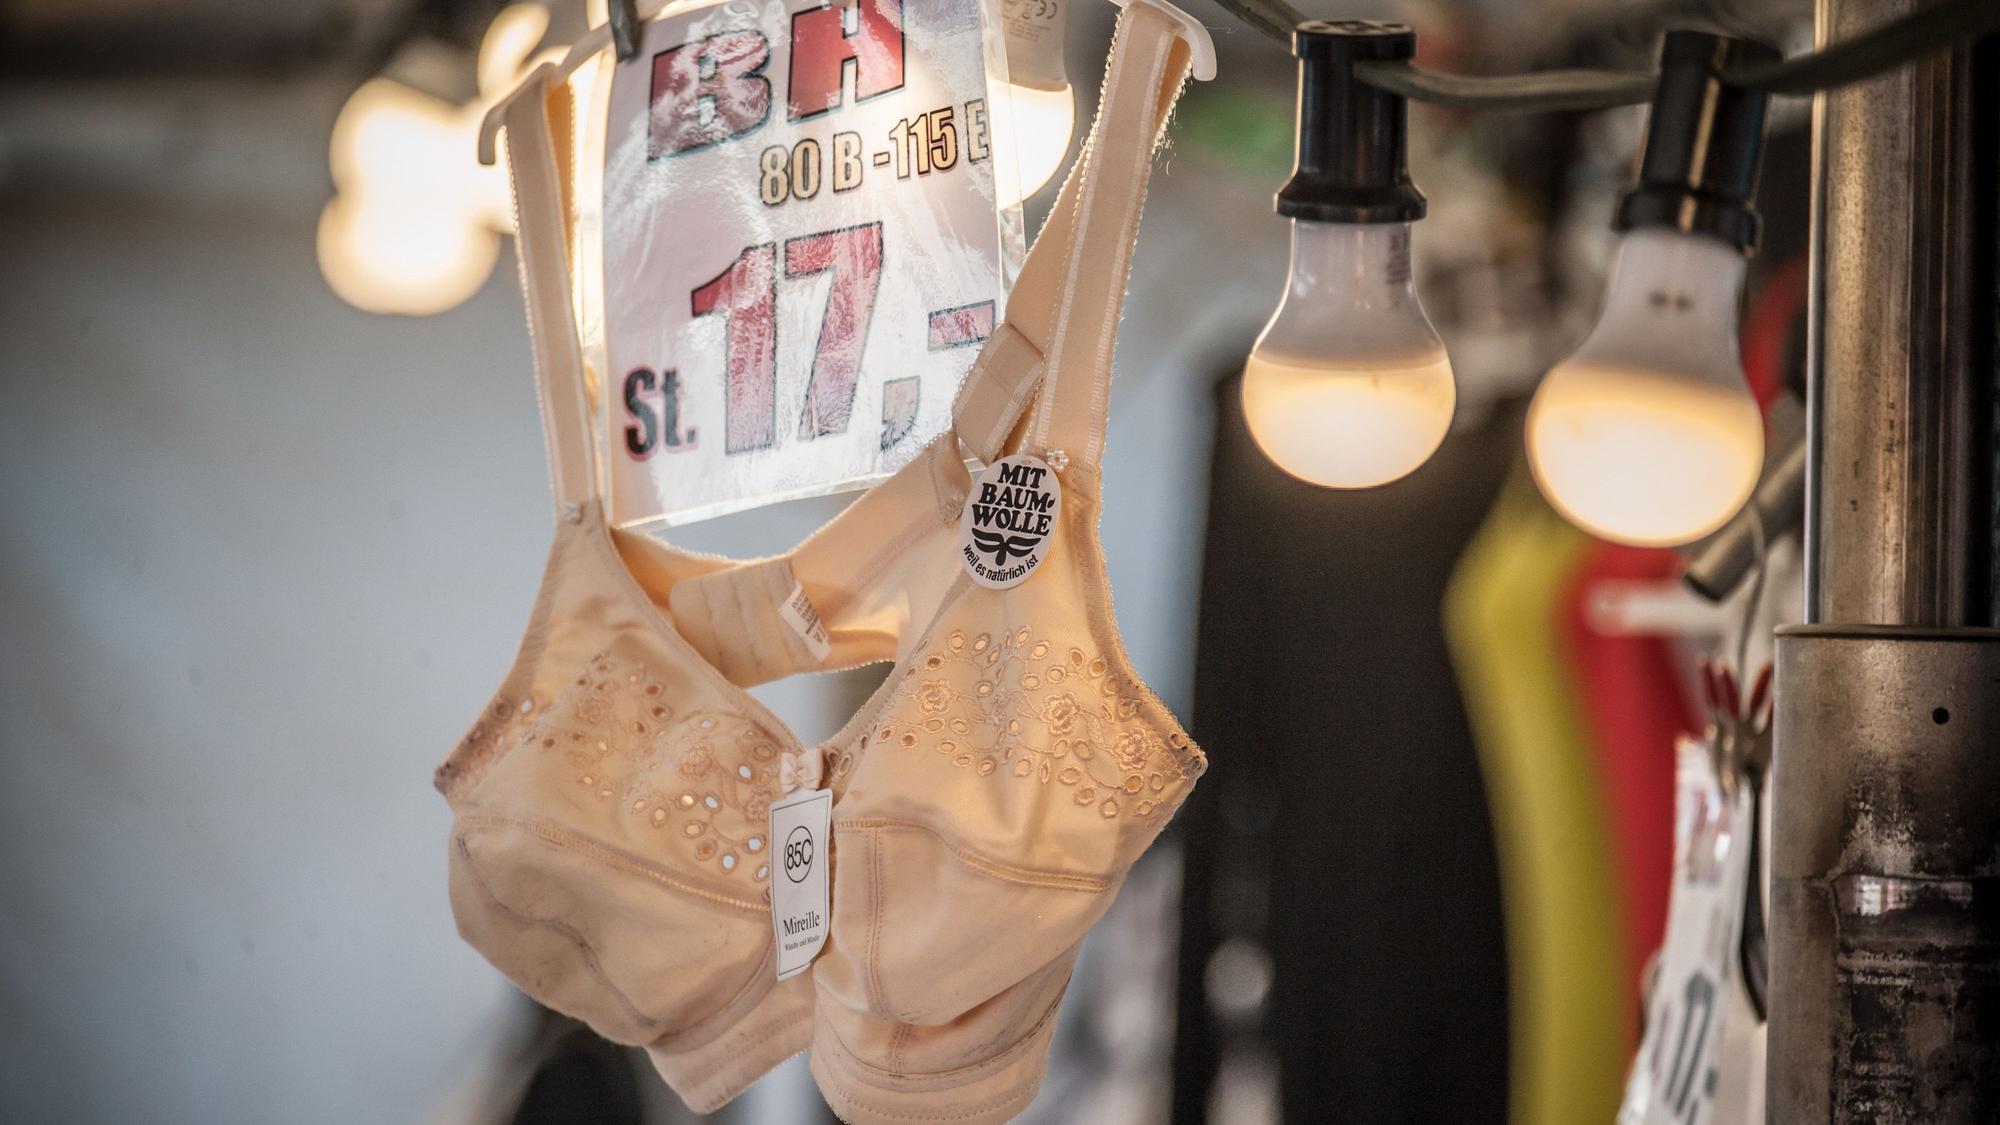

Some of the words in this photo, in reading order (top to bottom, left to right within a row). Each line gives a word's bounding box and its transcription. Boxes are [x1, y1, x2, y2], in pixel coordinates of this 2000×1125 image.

[648, 0, 906, 162] BH
[760, 137, 822, 207] 80
[832, 130, 864, 193] B
[964, 97, 990, 163] E
[622, 366, 699, 460] St.
[997, 462, 1047, 489] MIT
[978, 482, 1056, 513] BAUM-
[971, 503, 1052, 537] WOLLE
[963, 544, 979, 567] weil
[975, 563, 985, 577] es
[986, 565, 1026, 582] natürlich
[1026, 554, 1039, 570] ist
[786, 838, 812, 871] 85C
[783, 910, 820, 936] Mireille
